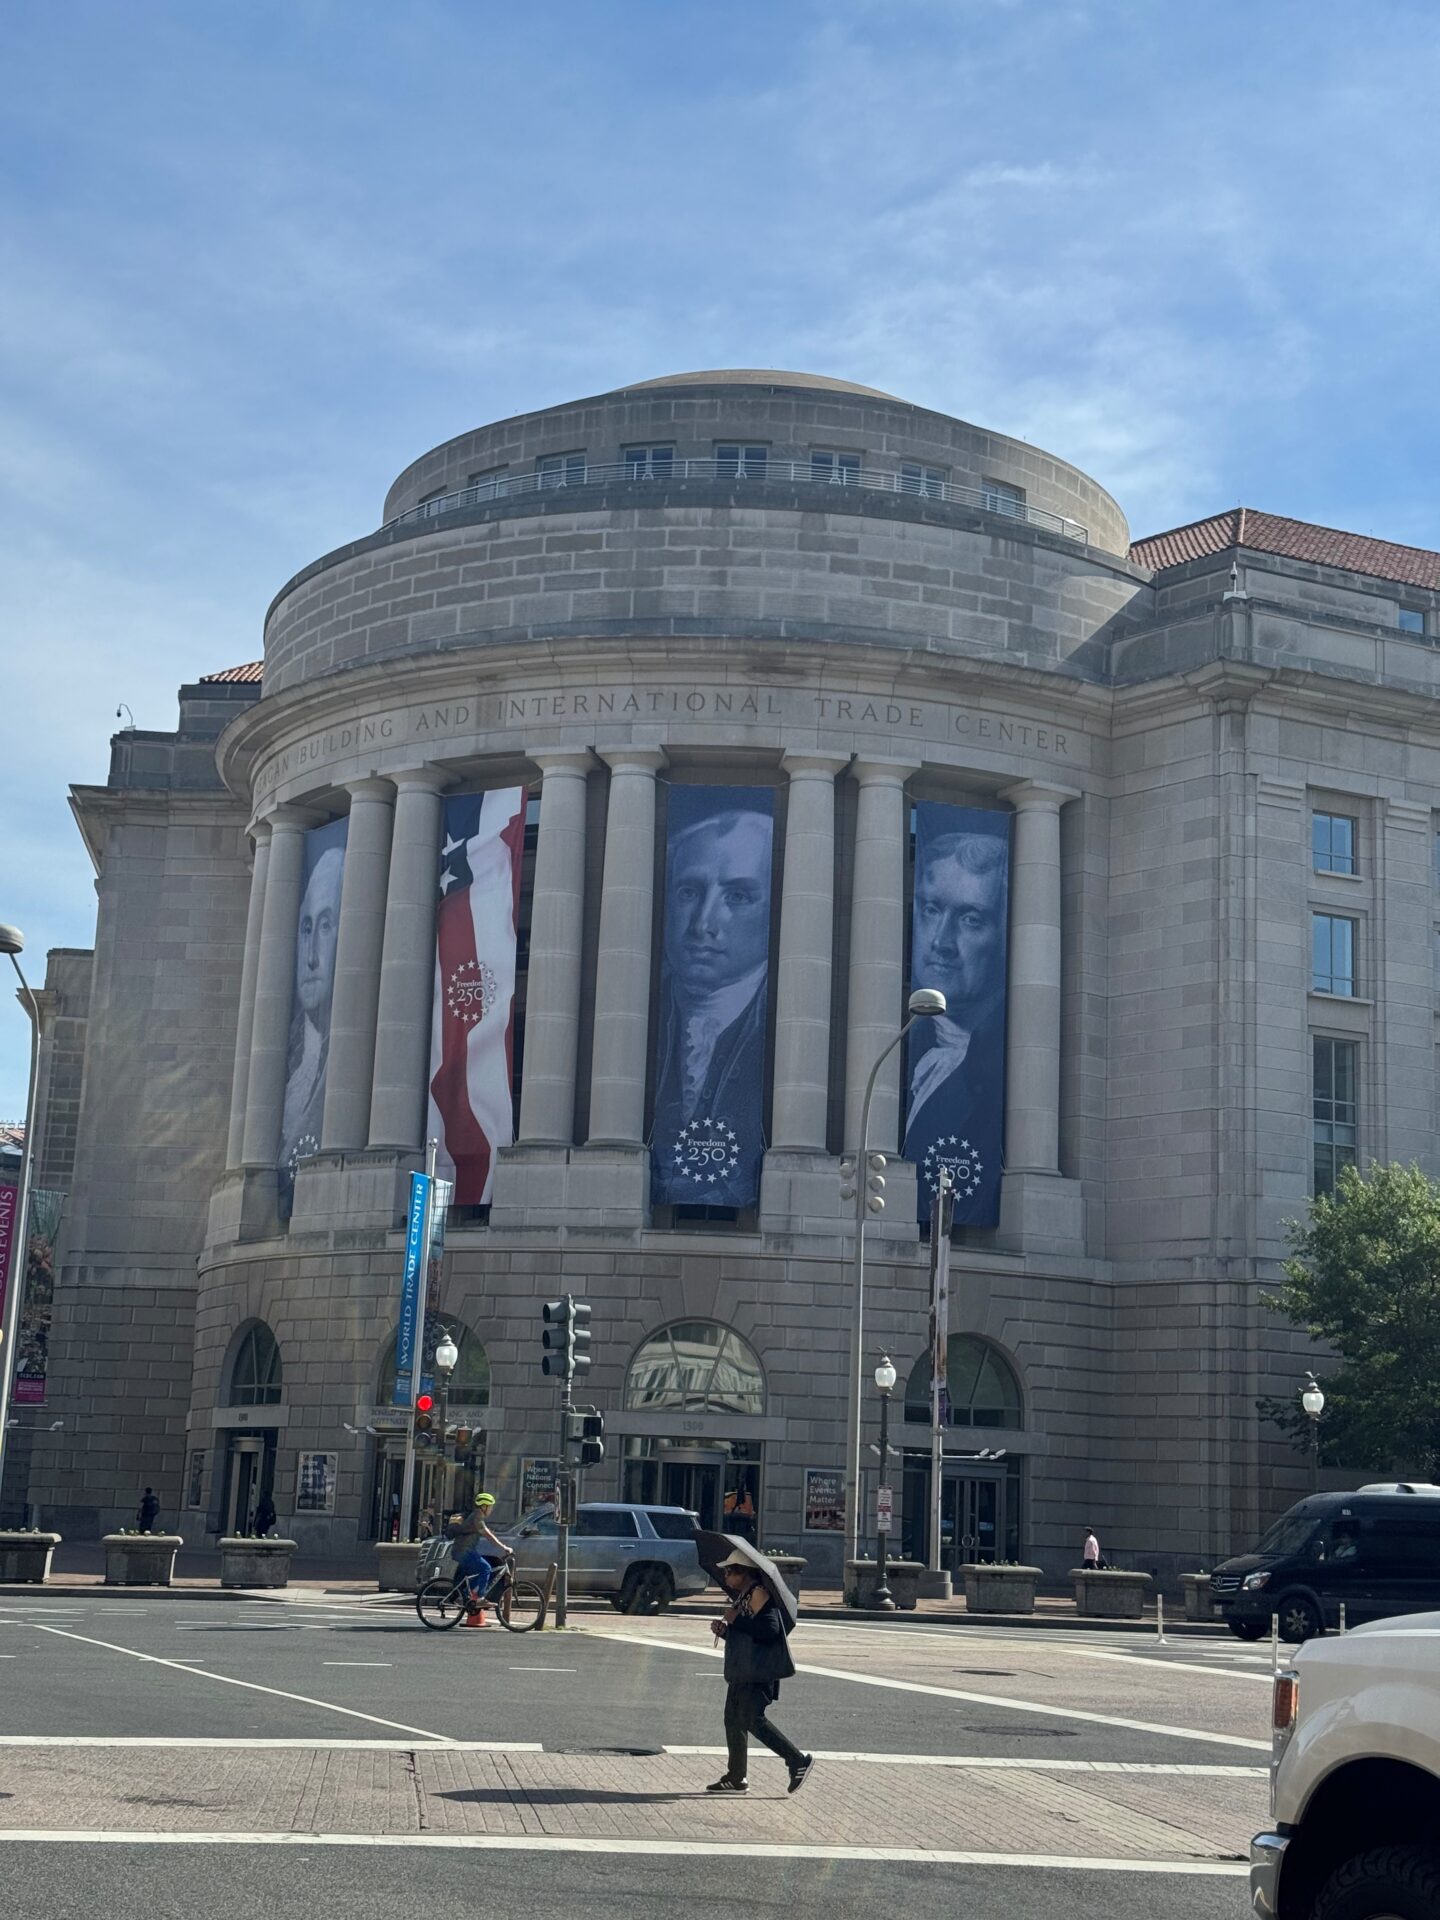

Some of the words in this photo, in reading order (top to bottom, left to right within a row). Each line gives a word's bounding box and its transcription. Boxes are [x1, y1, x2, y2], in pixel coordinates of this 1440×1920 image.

[300, 718, 393, 764] BUILDING
[415, 706, 469, 732] AND
[497, 691, 782, 720] INTERNATIONAL
[814, 697, 924, 728] TRADE
[955, 714, 1068, 754] CENTER
[456, 987, 485, 1007] 250
[687, 1139, 726, 1147] Freedom
[688, 1147, 726, 1166] 250
[935, 1155, 970, 1165] Freedom
[411, 1183, 423, 1246] CENTER
[406, 1249, 417, 1299] TRADE
[401, 1305, 412, 1365] WORLD
[809, 1485, 836, 1494] Events
[810, 1475, 837, 1485] Where
[809, 1495, 836, 1504] Matter
